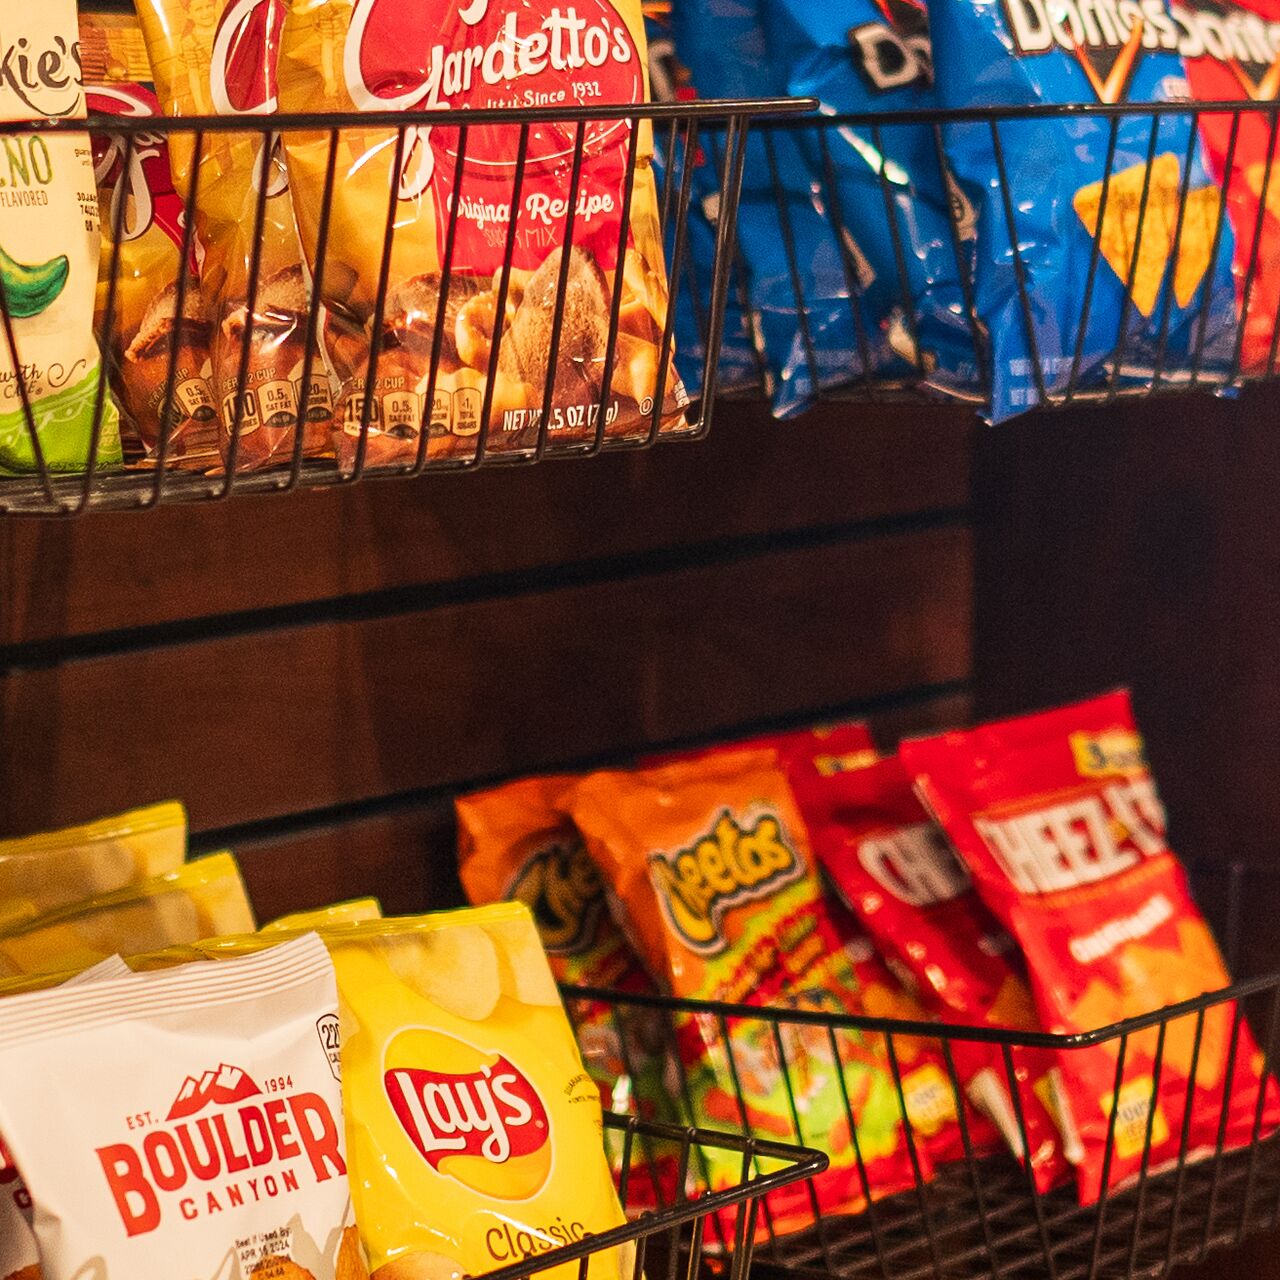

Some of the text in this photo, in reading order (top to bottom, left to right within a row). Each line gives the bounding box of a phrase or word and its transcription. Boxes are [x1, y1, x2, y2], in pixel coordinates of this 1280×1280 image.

[523, 89, 566, 108] Since
[571, 81, 602, 98] 1932
[0, 190, 49, 208] FLAVORED
[447, 192, 522, 230] rigina
[526, 226, 559, 249] MIX
[255, 368, 277, 383] CUP
[384, 376, 405, 389] CUP
[3, 381, 37, 400] CAE
[223, 391, 257, 417] 10
[503, 410, 526, 432] NET
[566, 405, 585, 428] OZ
[126, 1075, 293, 1130] EST. 1994
[394, 1063, 532, 1163] Lay's
[95, 1091, 348, 1238] BOULDER
[179, 1169, 300, 1221] CANYON
[486, 1216, 586, 1262] Classic
